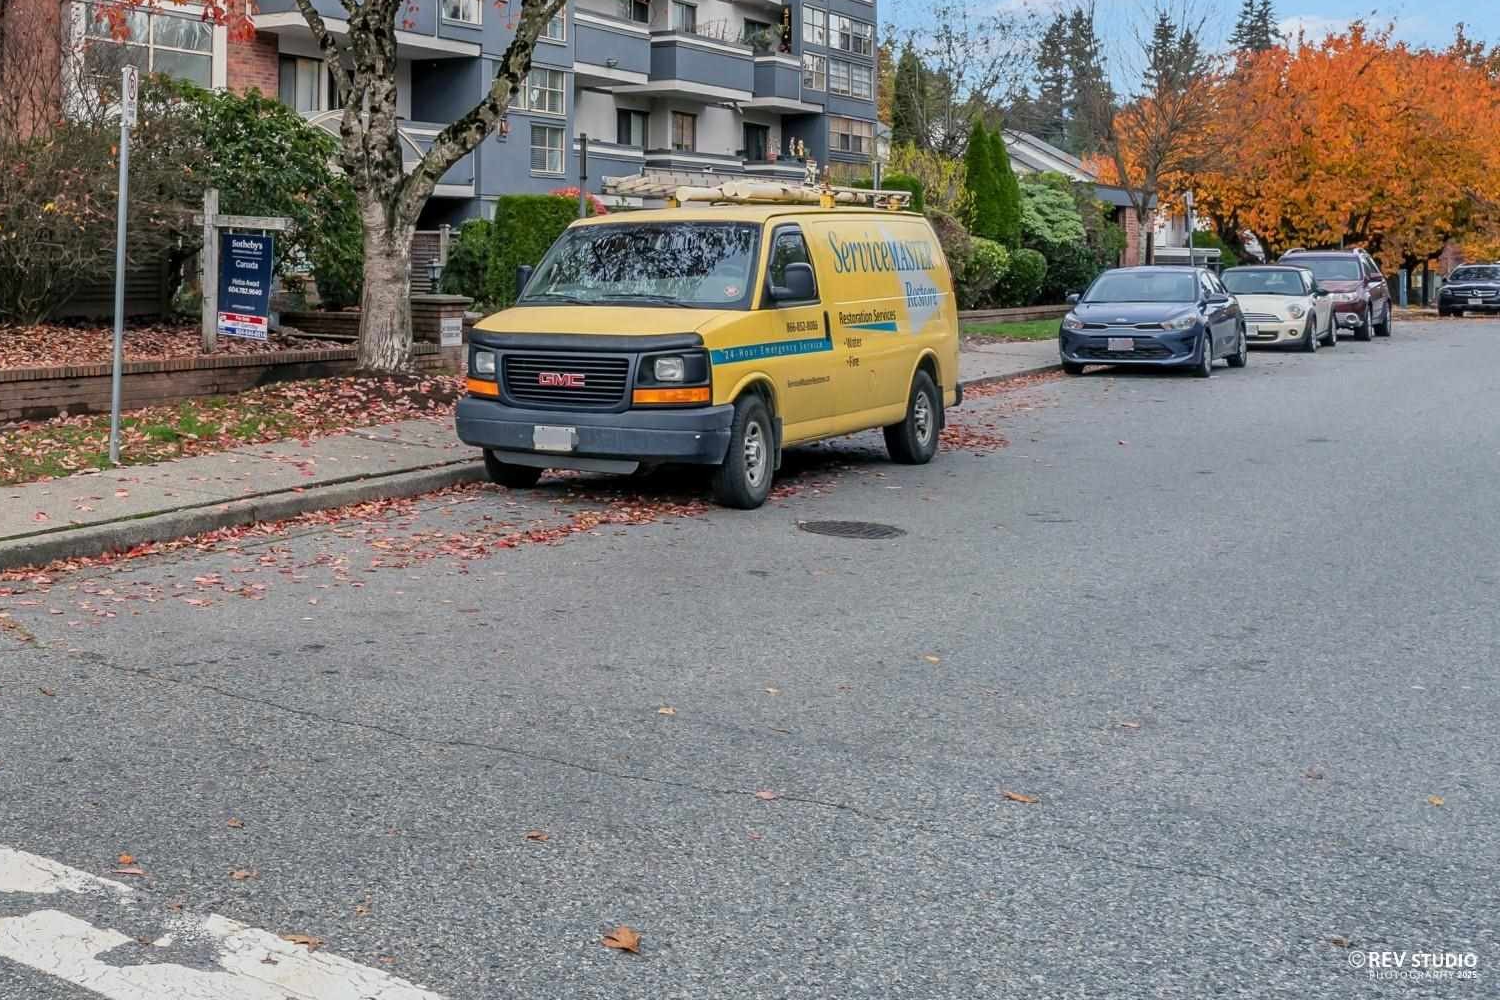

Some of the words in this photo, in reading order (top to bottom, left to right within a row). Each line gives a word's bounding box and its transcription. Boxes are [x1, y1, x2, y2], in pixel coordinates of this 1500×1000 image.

[231, 239, 263, 251] Sotheby's
[235, 259, 259, 270] Canada
[838, 310, 873, 325] Restoration
[873, 309, 897, 322] Services
[724, 349, 757, 361] 24-Hour
[759, 344, 797, 356] Emergency
[538, 371, 586, 387] GMC
